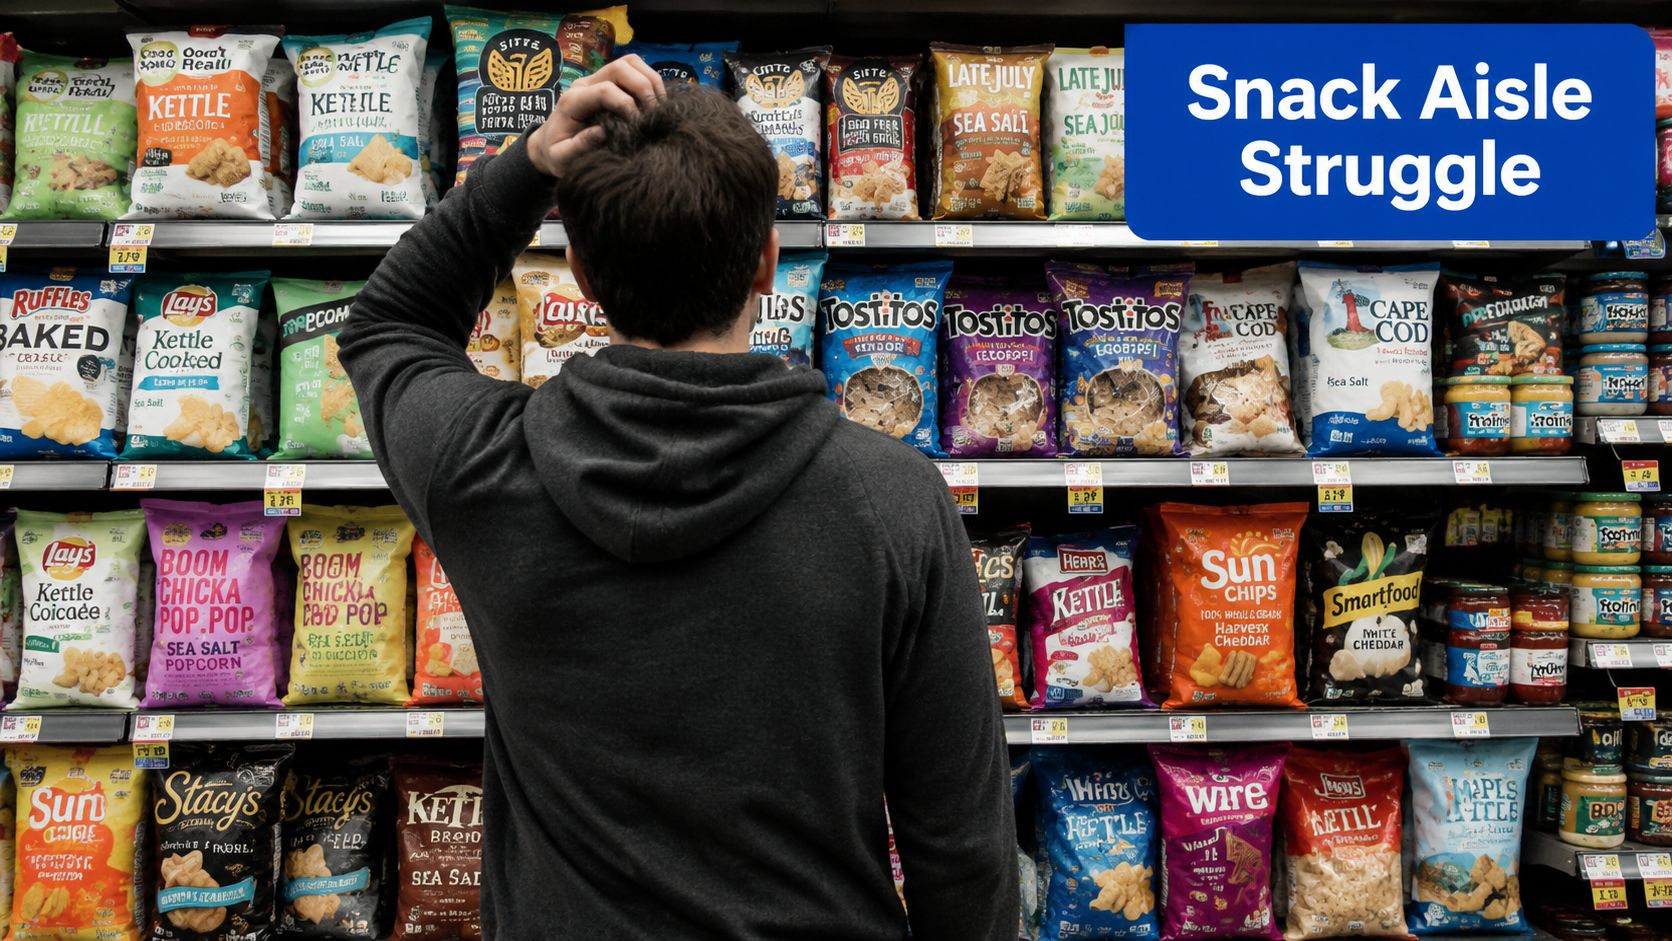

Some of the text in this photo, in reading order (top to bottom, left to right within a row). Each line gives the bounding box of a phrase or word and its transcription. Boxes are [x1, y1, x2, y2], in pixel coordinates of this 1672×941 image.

[949, 62, 991, 89] LATE
[1058, 67, 1101, 92] LATE
[148, 93, 231, 121] KETTLE
[953, 111, 987, 137] SEA
[1369, 300, 1429, 321] CAPE
[152, 330, 214, 349] Kettle
[1235, 321, 1277, 337] COD
[1375, 321, 1429, 343] COD
[160, 549, 230, 577] BOOM
[301, 552, 363, 580] BOOM
[1201, 549, 1277, 590] Sun
[160, 577, 242, 605] CHICKA
[1224, 585, 1277, 604] CHIPS
[1331, 577, 1420, 617] Smartfood
[346, 602, 388, 625] POP
[167, 641, 240, 656] SEA SALT
[1353, 640, 1404, 650] CHEDDAR
[166, 657, 241, 671] POPCORN
[155, 770, 262, 832] Stacy's
